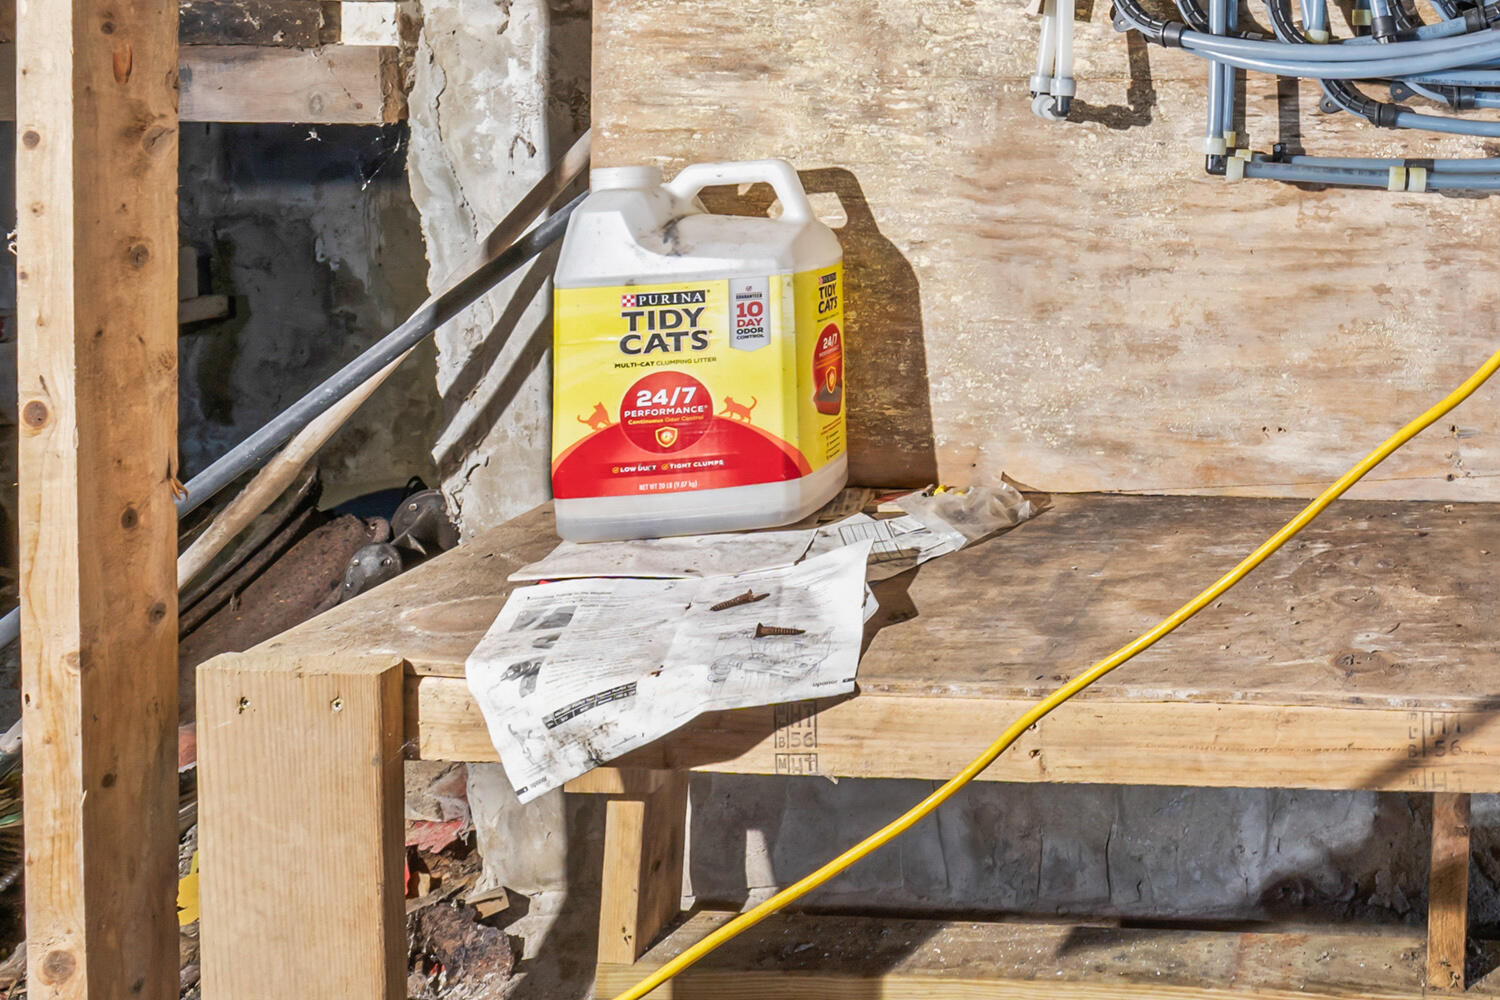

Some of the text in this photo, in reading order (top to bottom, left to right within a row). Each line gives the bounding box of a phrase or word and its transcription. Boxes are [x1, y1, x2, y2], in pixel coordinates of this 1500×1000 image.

[638, 291, 704, 306] PURINA
[818, 281, 837, 299] TIDY
[736, 301, 764, 318] 10
[818, 296, 838, 314] CATS
[621, 306, 706, 332] TIDY
[736, 317, 764, 328] DAY
[736, 327, 764, 335] ODOR
[619, 329, 709, 355] CATS
[823, 333, 838, 350] 24/7
[614, 356, 717, 369] MULTI-CAT CLUMPING LITTER
[636, 386, 697, 407] 24/7
[624, 405, 704, 418] PERFORMANCE
[791, 731, 814, 748] 56
[1434, 739, 1462, 757] 56
